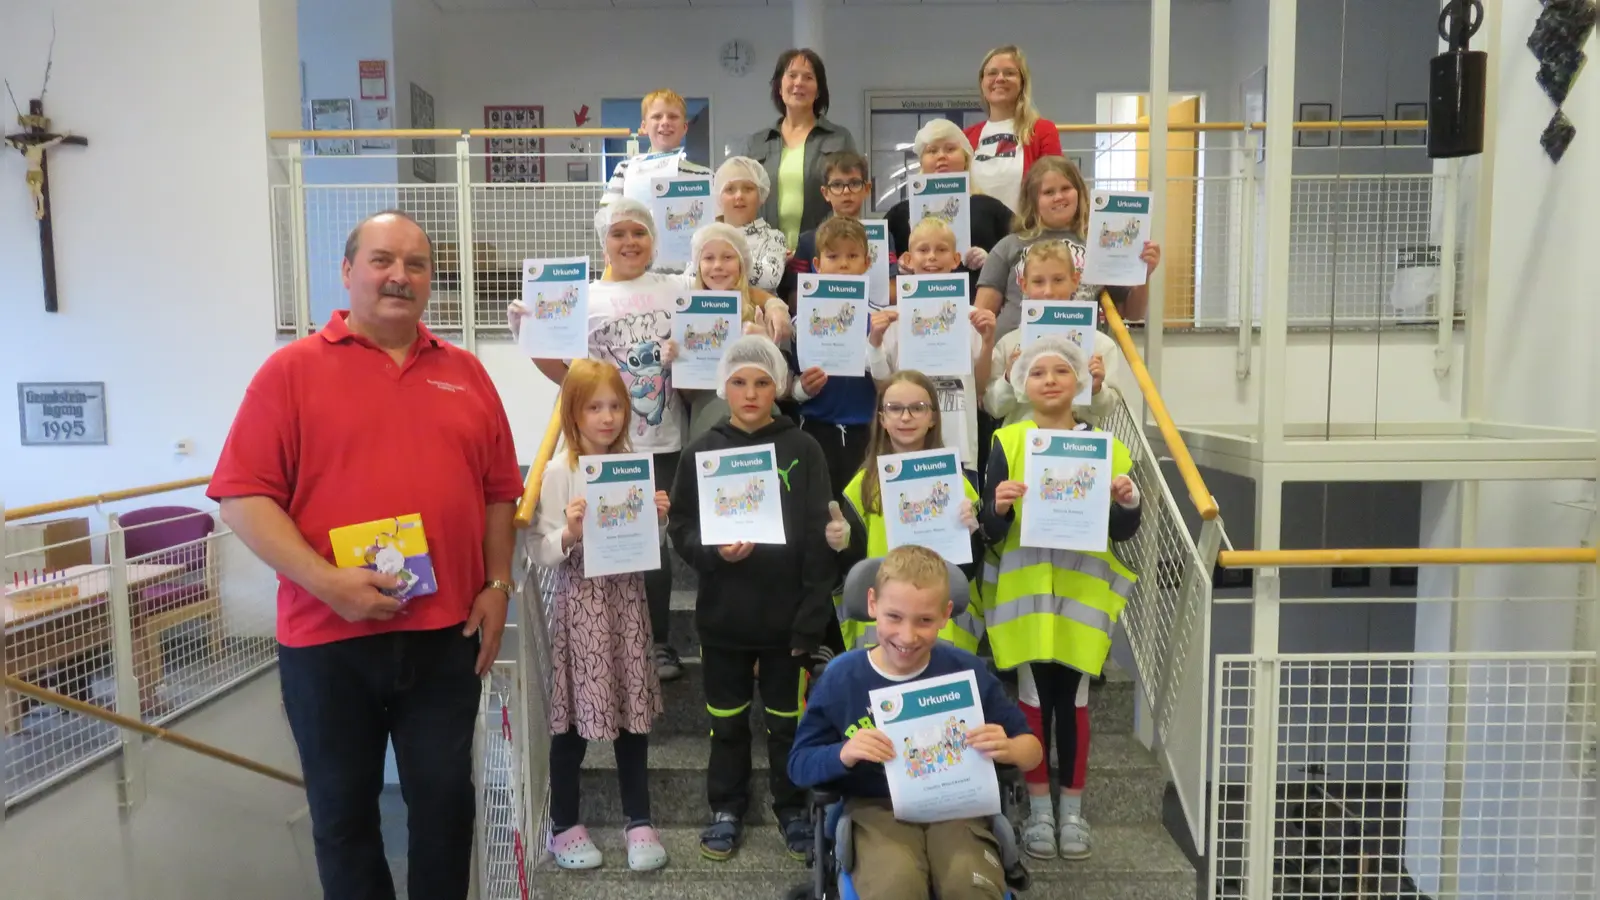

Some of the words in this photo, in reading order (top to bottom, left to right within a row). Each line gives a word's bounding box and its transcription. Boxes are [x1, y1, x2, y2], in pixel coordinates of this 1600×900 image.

[1117, 200, 1142, 208] Urkunde
[552, 268, 580, 276] Urkunde
[828, 285, 857, 293] Urkunde
[1053, 312, 1084, 320] Urkunde
[42, 420, 86, 440] 1995
[1063, 442, 1097, 452] Urkunde
[731, 457, 763, 468] Urkunde
[913, 461, 947, 472] Urkunde
[612, 466, 642, 475] Urkunde
[918, 691, 961, 707] Urkunde
